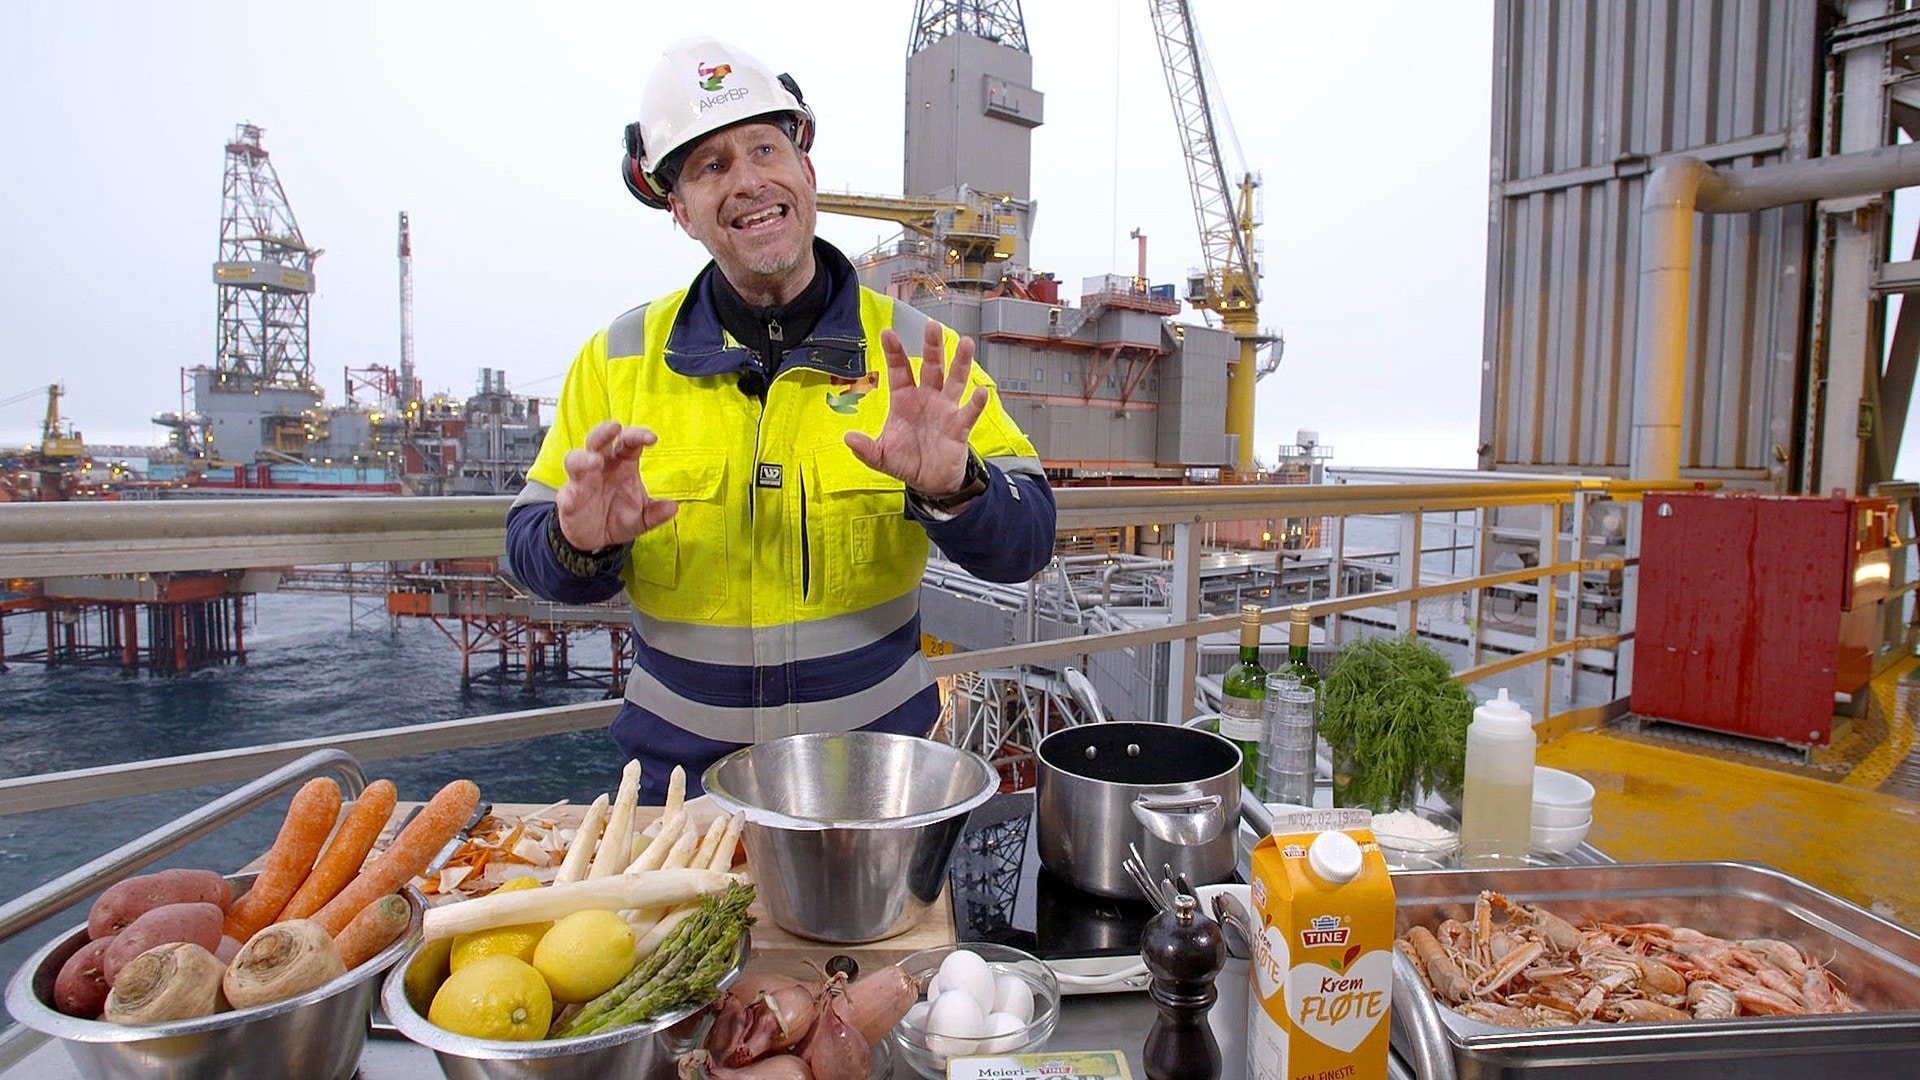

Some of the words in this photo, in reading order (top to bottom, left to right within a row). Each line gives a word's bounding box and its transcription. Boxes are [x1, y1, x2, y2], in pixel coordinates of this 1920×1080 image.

[1300, 811, 1349, 827] 02.02.19
[1307, 931, 1343, 943] TINE
[1320, 977, 1363, 994] Krem
[1300, 991, 1383, 1026] FLØTE
[978, 1068, 1029, 1077] Meieri-
[1319, 1065, 1356, 1080] FINESTE
